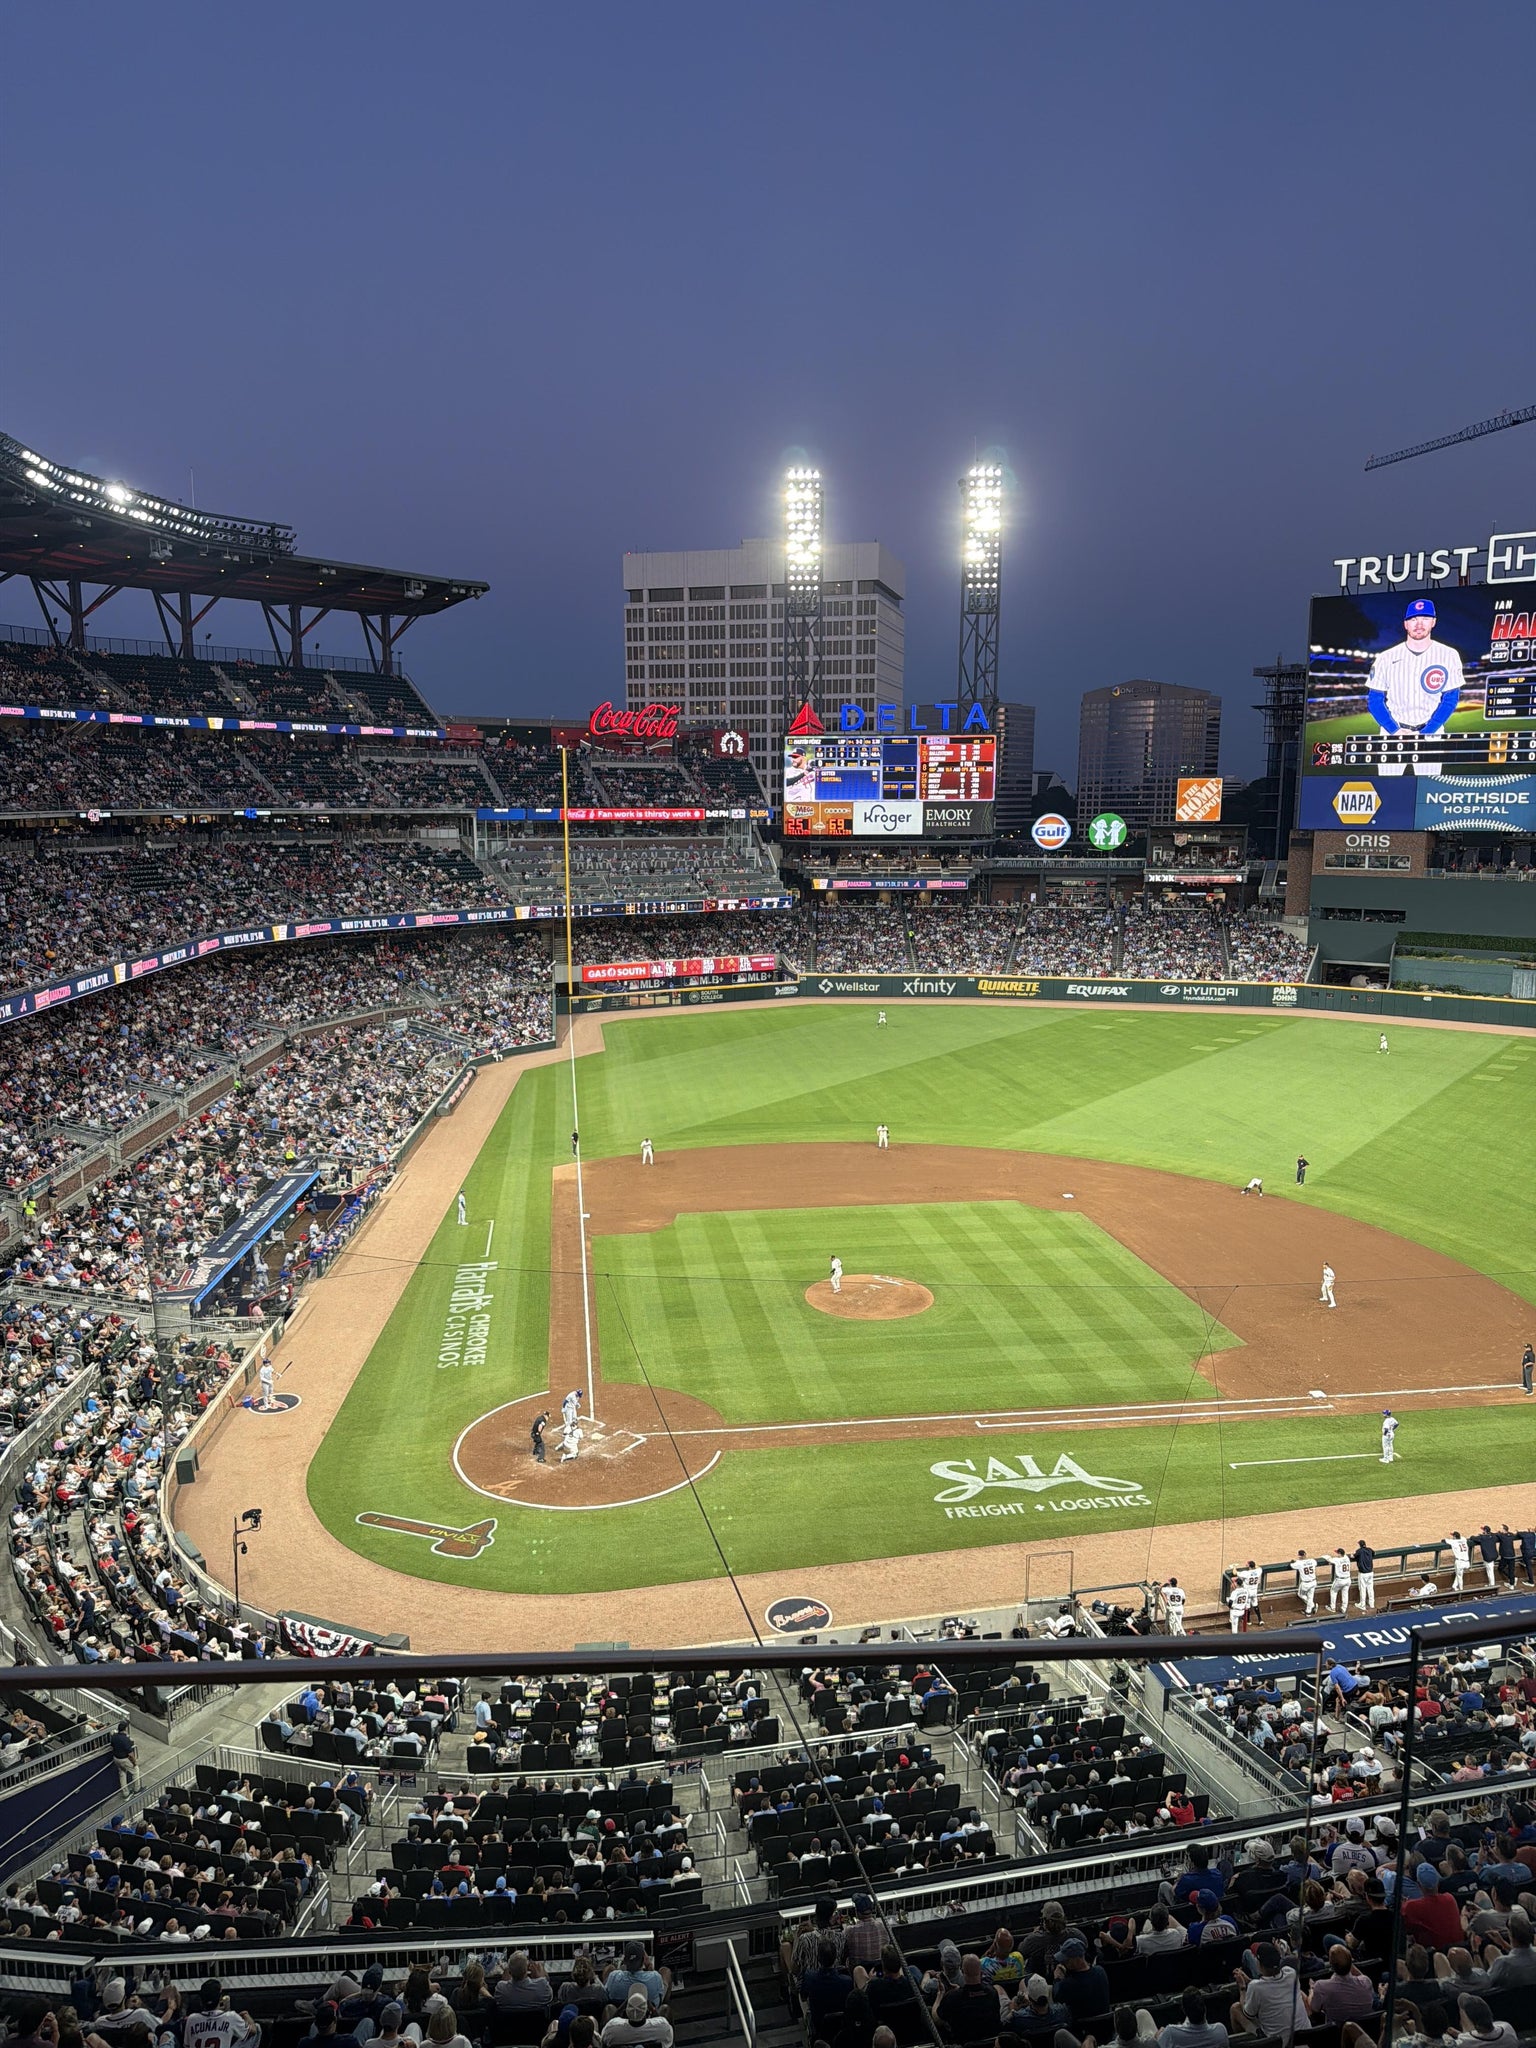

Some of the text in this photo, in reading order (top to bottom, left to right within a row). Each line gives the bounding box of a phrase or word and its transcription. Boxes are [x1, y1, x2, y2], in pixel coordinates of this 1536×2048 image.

[1334, 546, 1478, 587] TRUIST
[1495, 600, 1513, 610] IAN
[590, 701, 682, 738] Coca-Cola
[840, 702, 990, 732] DELTA
[1350, 744, 1357, 752] 0
[1366, 744, 1372, 752] 0
[1382, 743, 1388, 751] 0
[1414, 742, 1418, 750] 1
[1496, 740, 1500, 748] 1
[1512, 740, 1519, 748] 3
[1350, 754, 1356, 763] 0
[1366, 754, 1372, 762] 0
[1380, 754, 1387, 762] 0
[1412, 754, 1419, 762] 0
[1496, 752, 1500, 760] 1
[1510, 752, 1518, 760] 4
[1528, 752, 1536, 760] 0
[1182, 783, 1200, 800] THE
[1176, 778, 1220, 820] HOME
[1341, 794, 1374, 812] NAPA
[1426, 792, 1530, 804] NORTHSIDE
[1193, 794, 1221, 820] DEPOT
[1443, 806, 1509, 814] HOSPITAL
[598, 810, 616, 818] Fan
[618, 810, 635, 818] work
[636, 810, 643, 818] is
[644, 810, 670, 819] thirsty
[672, 810, 692, 818] work
[864, 804, 912, 832] Kroger
[926, 809, 974, 821] EMORY
[829, 818, 845, 830] 69
[926, 820, 971, 828] HEALTHCARE
[1035, 826, 1067, 836] Gulf
[1346, 834, 1391, 848] ORIS
[588, 970, 607, 978] GAS
[617, 967, 646, 976] SOUTH
[651, 966, 662, 974] AL
[748, 972, 772, 982] MLB+
[640, 980, 666, 989] MLB+
[700, 976, 724, 985] MLB+
[978, 980, 1040, 992] QUIKRETE
[836, 982, 880, 992] Wellstar
[903, 978, 956, 996] xfinity
[1066, 984, 1129, 997] EQUIFAX
[1183, 986, 1238, 996] HYUNDAI
[1273, 986, 1297, 996] PAPA
[1272, 994, 1297, 1002] JOHNS
[449, 1261, 498, 1314] Harrah's
[437, 1315, 467, 1369] CASINOS
[462, 1313, 492, 1366] CHEROKEE
[930, 1453, 1143, 1503] SAIA
[944, 1494, 1152, 1519] FREIGHT LOGISTICS
[1303, 1566, 1314, 1576] 85
[1248, 1576, 1259, 1586] 22
[1170, 1594, 1182, 1602] 83
[1342, 1850, 1366, 1862] ALBIES
[670, 1932, 690, 1942] ALERT
[1210, 1926, 1228, 1940] RILEY
